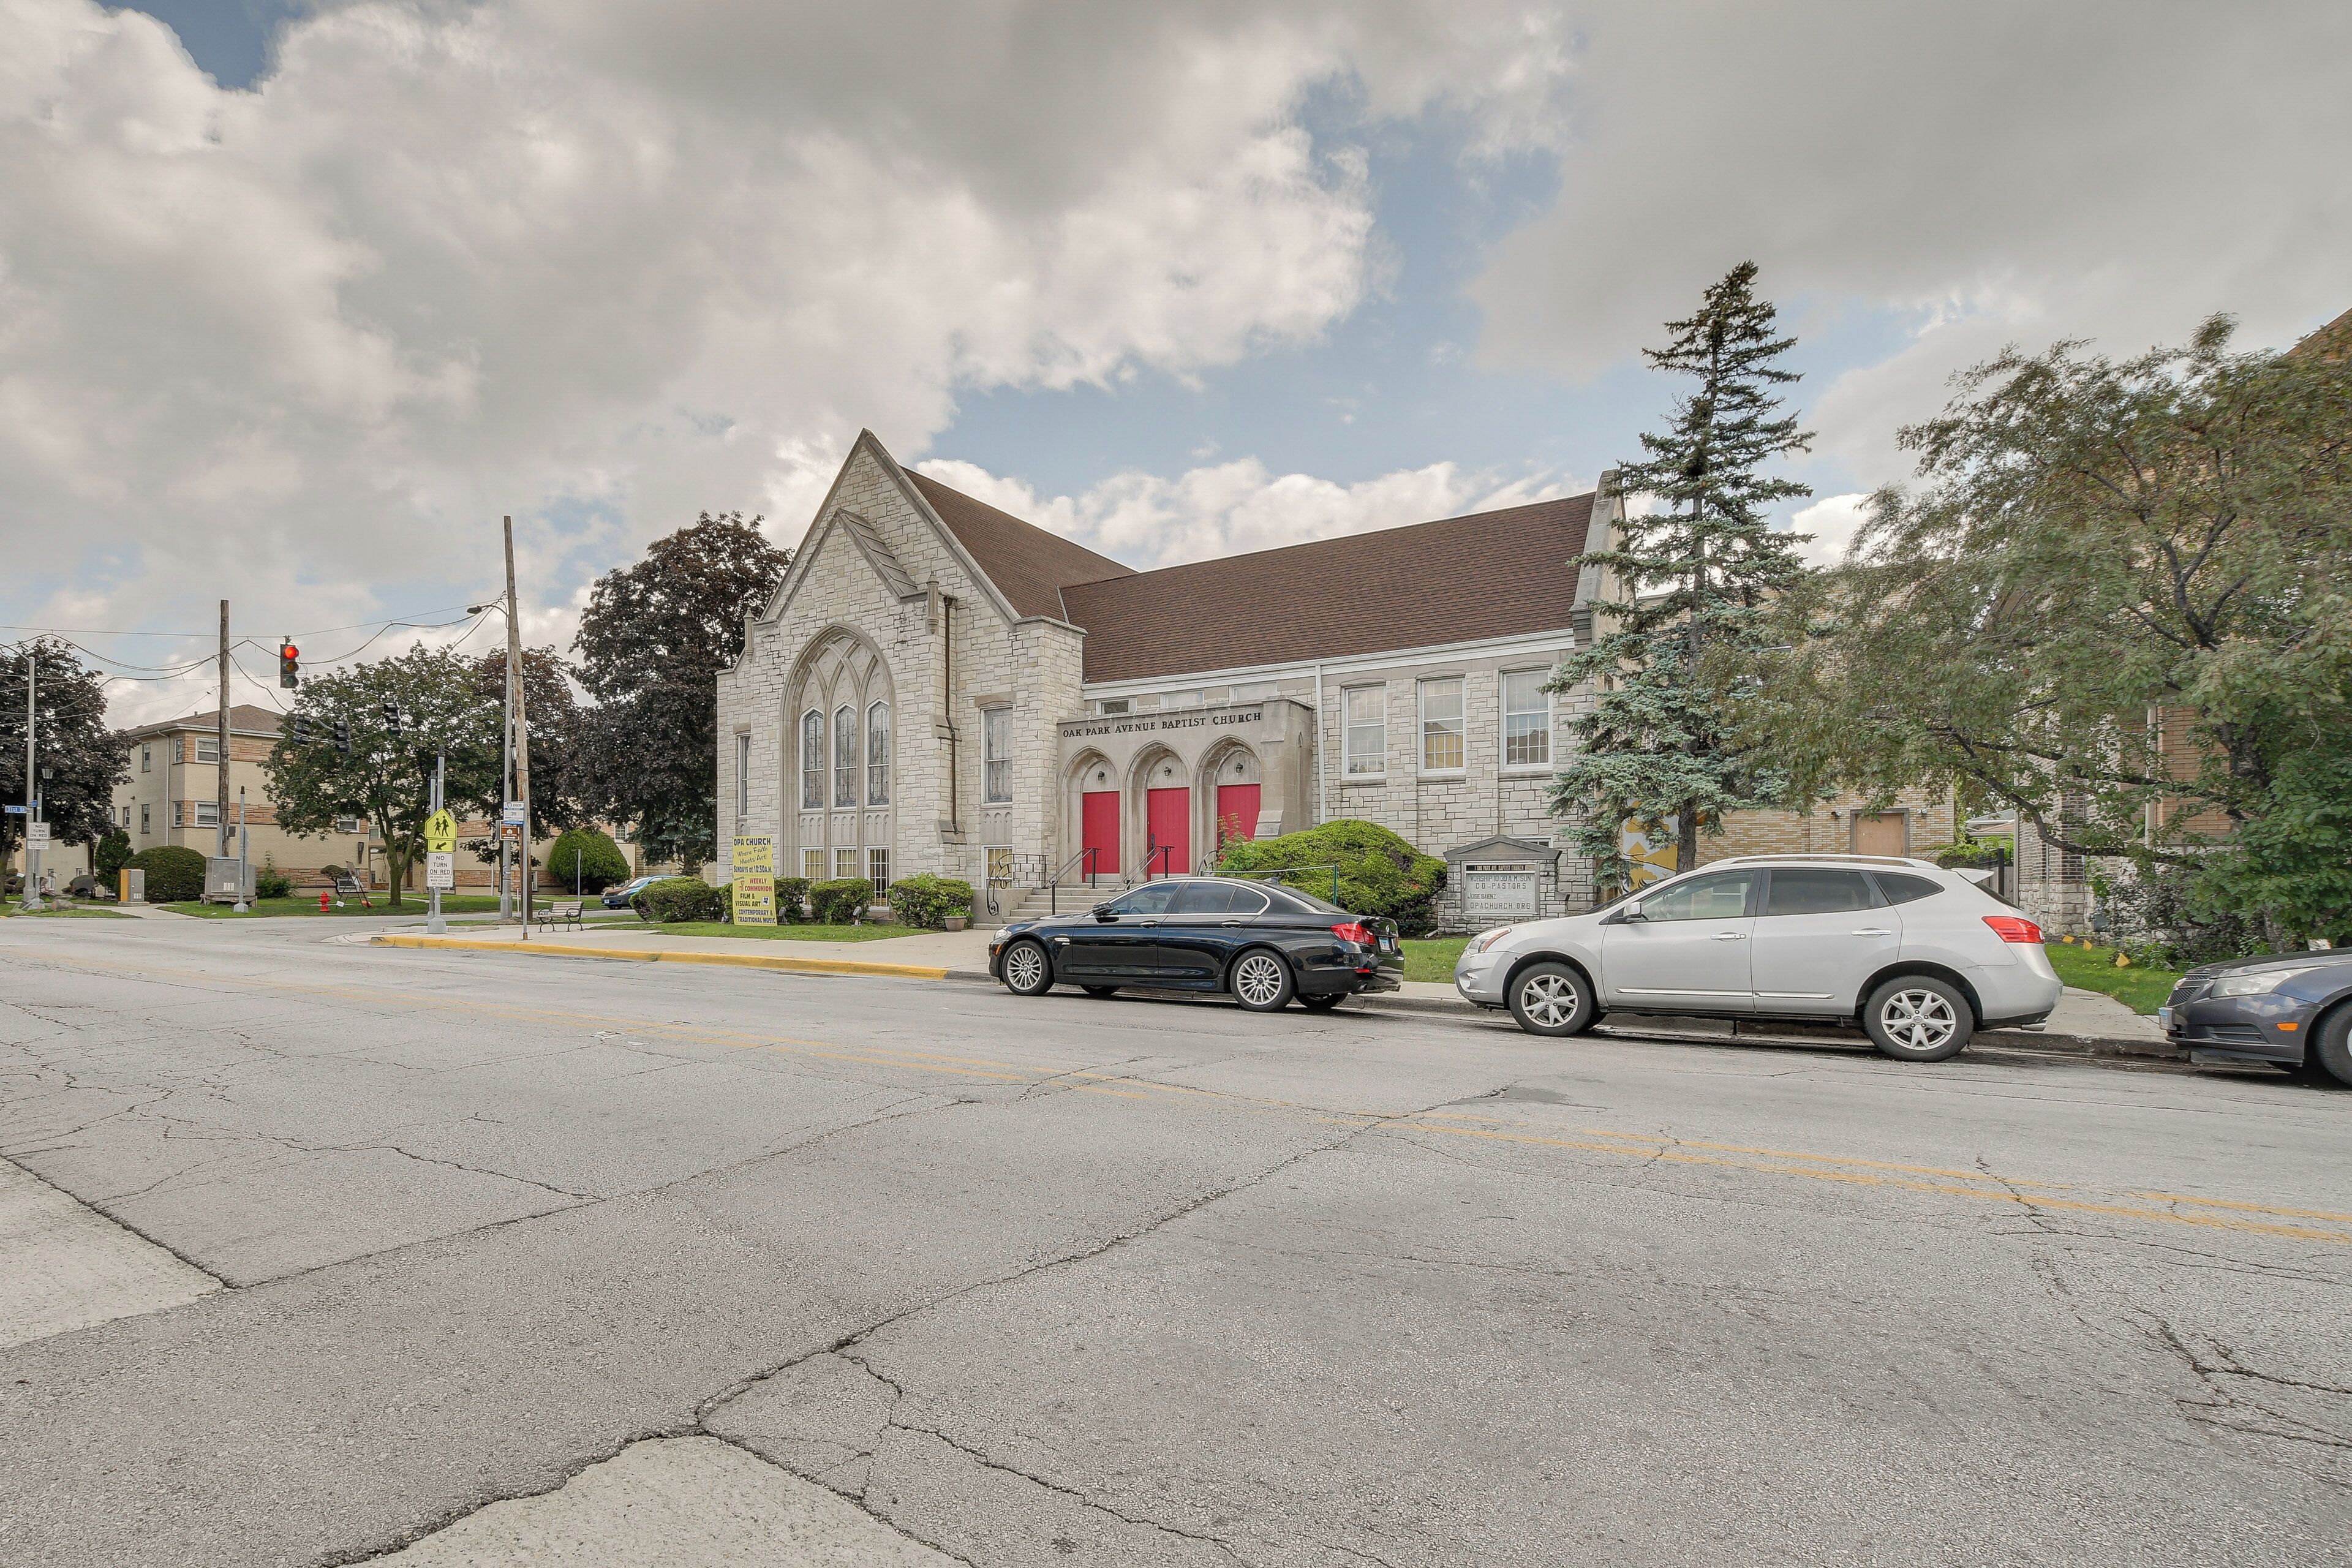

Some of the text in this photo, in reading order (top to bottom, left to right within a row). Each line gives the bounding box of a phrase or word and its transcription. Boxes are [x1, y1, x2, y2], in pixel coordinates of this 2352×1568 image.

[1063, 712, 1261, 737] OAK PARK AVENUE BAPTIST CHURCH
[746, 837, 771, 846] CHURCH
